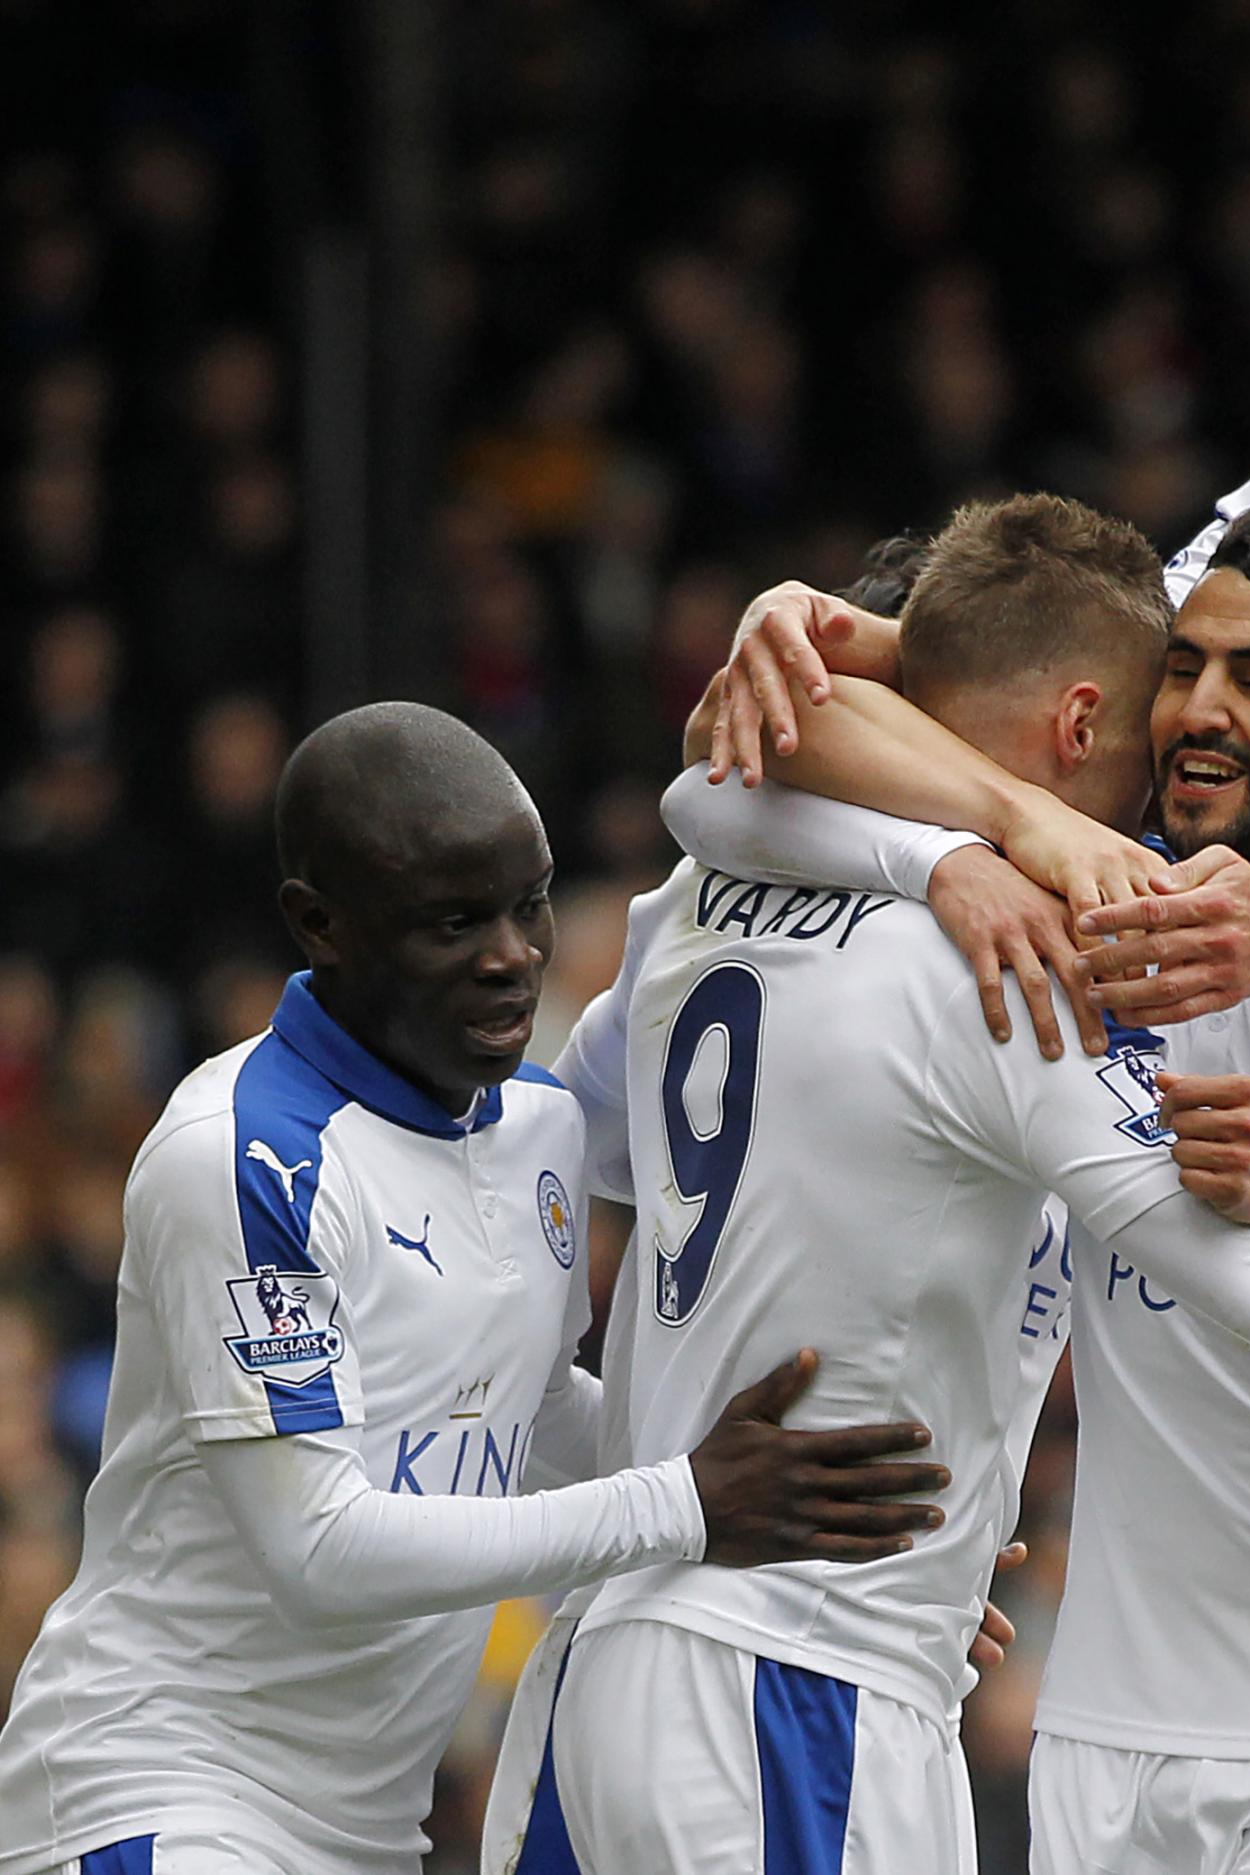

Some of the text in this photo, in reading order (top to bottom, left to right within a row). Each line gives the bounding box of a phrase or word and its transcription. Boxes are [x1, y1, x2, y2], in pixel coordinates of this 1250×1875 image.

[696, 869, 896, 950] VARDY
[654, 960, 767, 1327] 9
[249, 1335, 320, 1358] BARCLAYS
[250, 1353, 288, 1365] PREMIER
[390, 1414, 538, 1498] KIN
